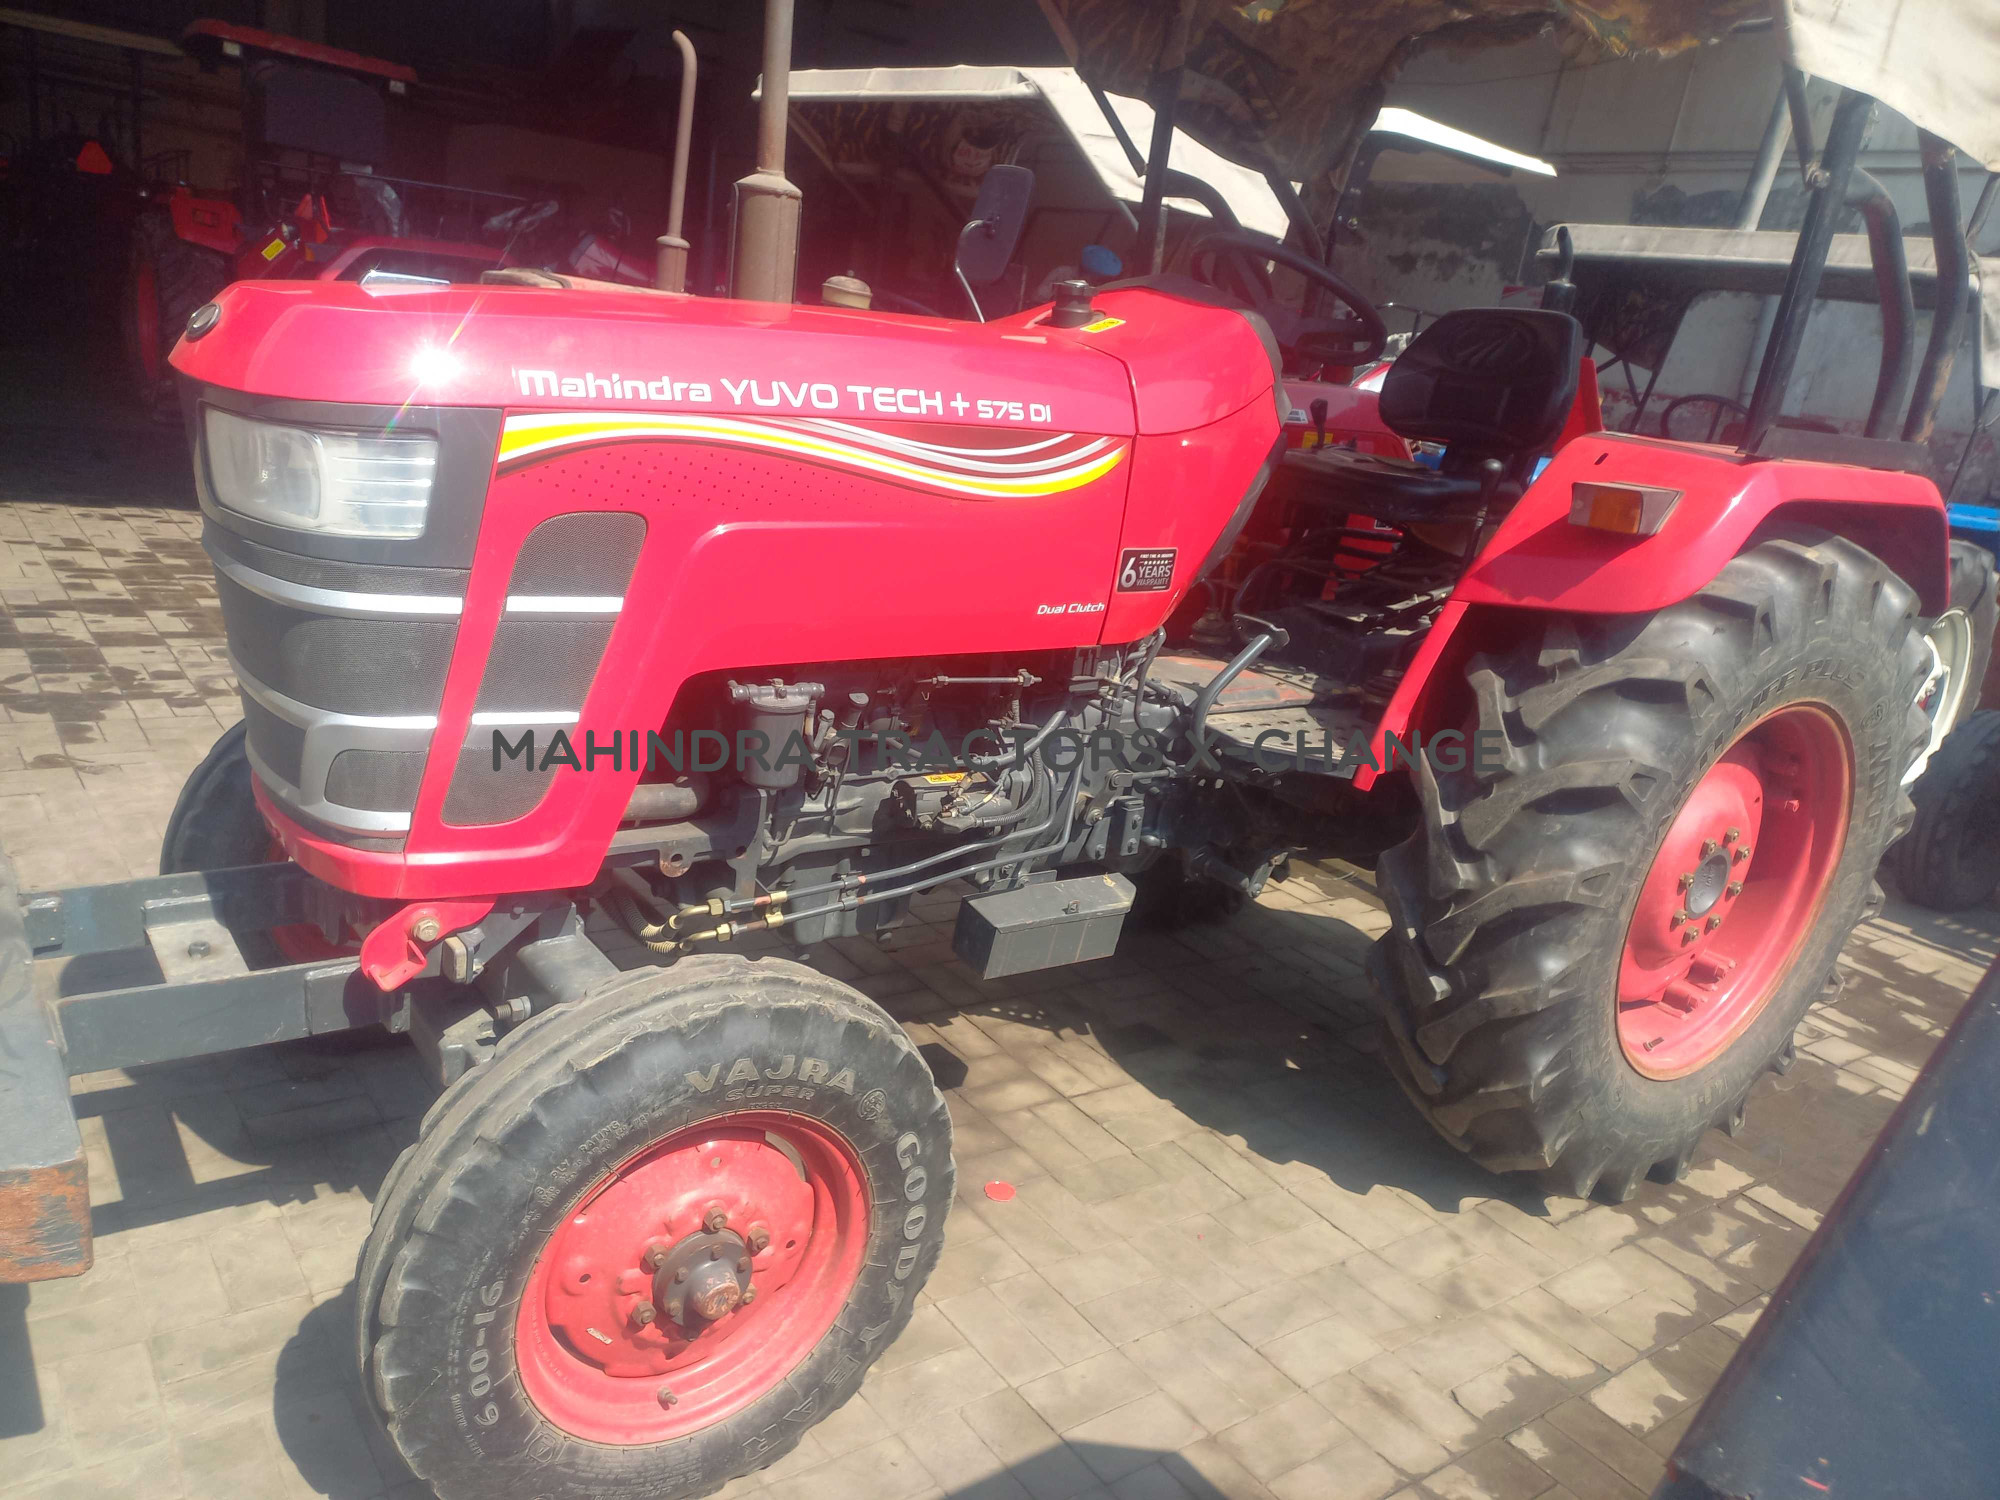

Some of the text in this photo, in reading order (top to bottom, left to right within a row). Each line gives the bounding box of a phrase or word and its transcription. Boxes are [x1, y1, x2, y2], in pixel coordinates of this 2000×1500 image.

[518, 368, 713, 402] Mahindra
[720, 378, 838, 408] YUVO
[847, 385, 943, 415] TECH
[977, 400, 1025, 420] 575
[1030, 403, 1052, 422] DI
[1121, 556, 1171, 588] 6 YEARS
[1037, 602, 1105, 615] Dual Clutch
[1800, 656, 1865, 690] PLUS
[684, 1055, 857, 1095] VAJRA
[725, 1084, 815, 1101] SUPER
[577, 1120, 622, 1153] RATING
